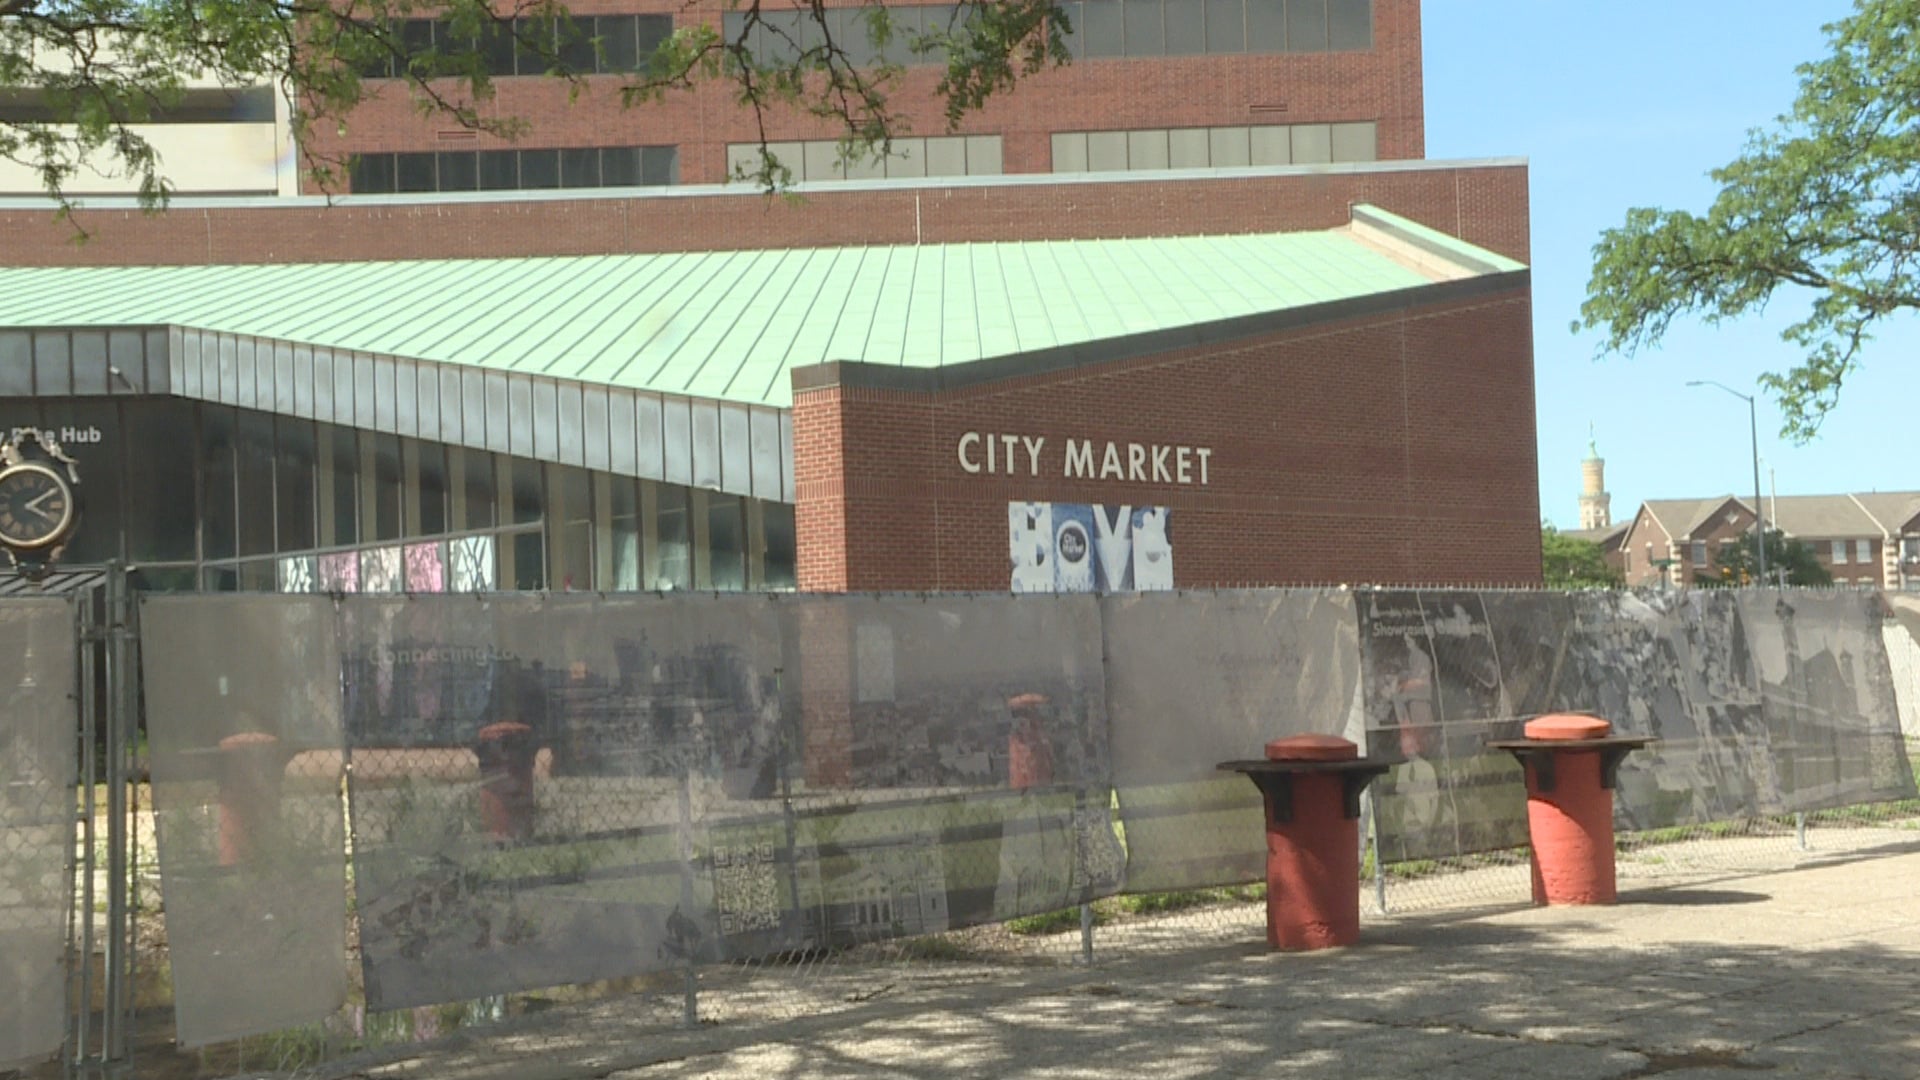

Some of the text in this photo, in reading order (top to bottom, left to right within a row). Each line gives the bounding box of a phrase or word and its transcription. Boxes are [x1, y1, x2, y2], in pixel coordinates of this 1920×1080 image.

[61, 426, 102, 443] Hub
[958, 431, 1212, 485] CITY MARKET
